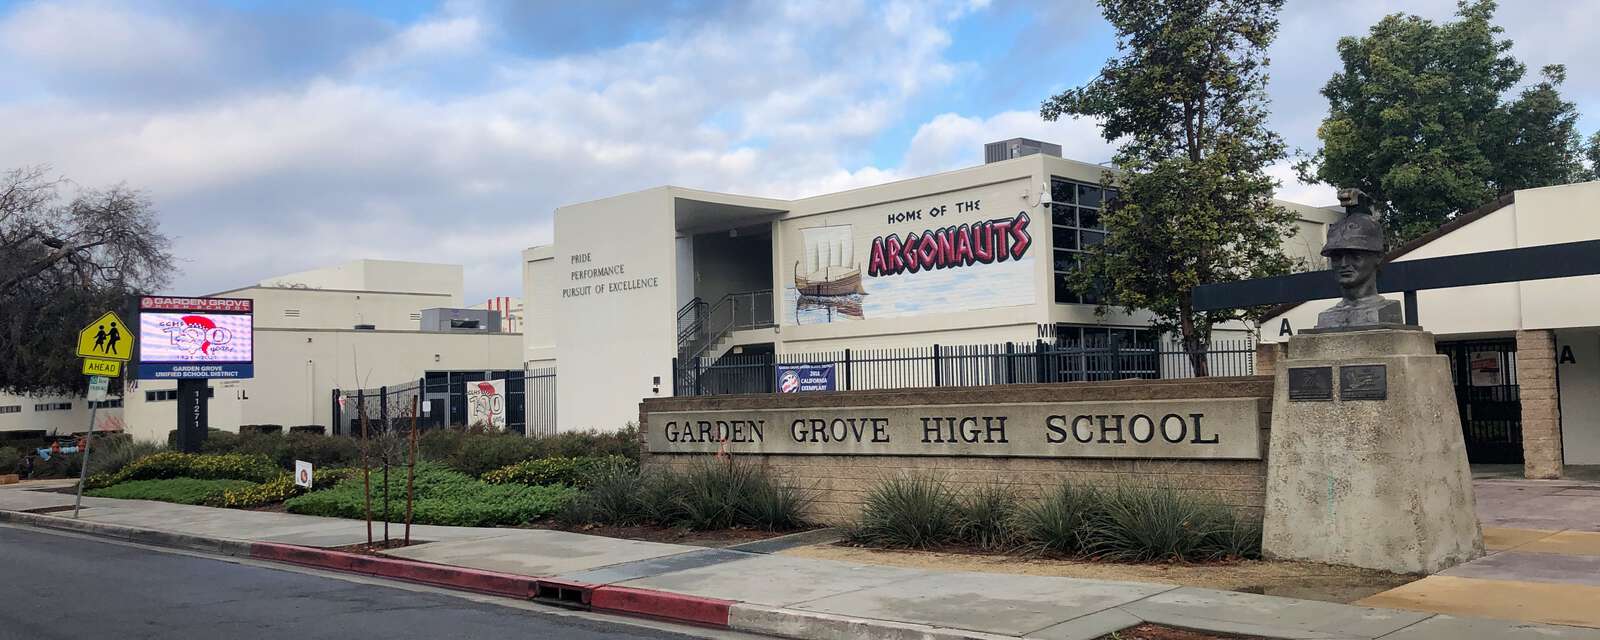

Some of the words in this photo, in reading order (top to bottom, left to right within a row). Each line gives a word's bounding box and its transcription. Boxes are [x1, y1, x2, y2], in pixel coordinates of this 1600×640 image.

[888, 209, 922, 224] HOME
[929, 205, 947, 218] OF
[955, 199, 981, 213] THE
[868, 211, 1032, 277] ARGONAUTS
[571, 253, 591, 264] PRIDE
[571, 264, 624, 280] PERFORMANCE
[562, 286, 592, 298] PURSUIT
[595, 284, 605, 294] OF
[609, 277, 659, 292] EXCELLENCE
[1279, 317, 1293, 337] A
[1560, 345, 1577, 364] A
[88, 363, 116, 372] AHEAD
[664, 420, 765, 443] GARDEN
[791, 417, 890, 443] GROVE
[920, 416, 1009, 444] HIGH
[1046, 413, 1219, 444] SCHOOL
